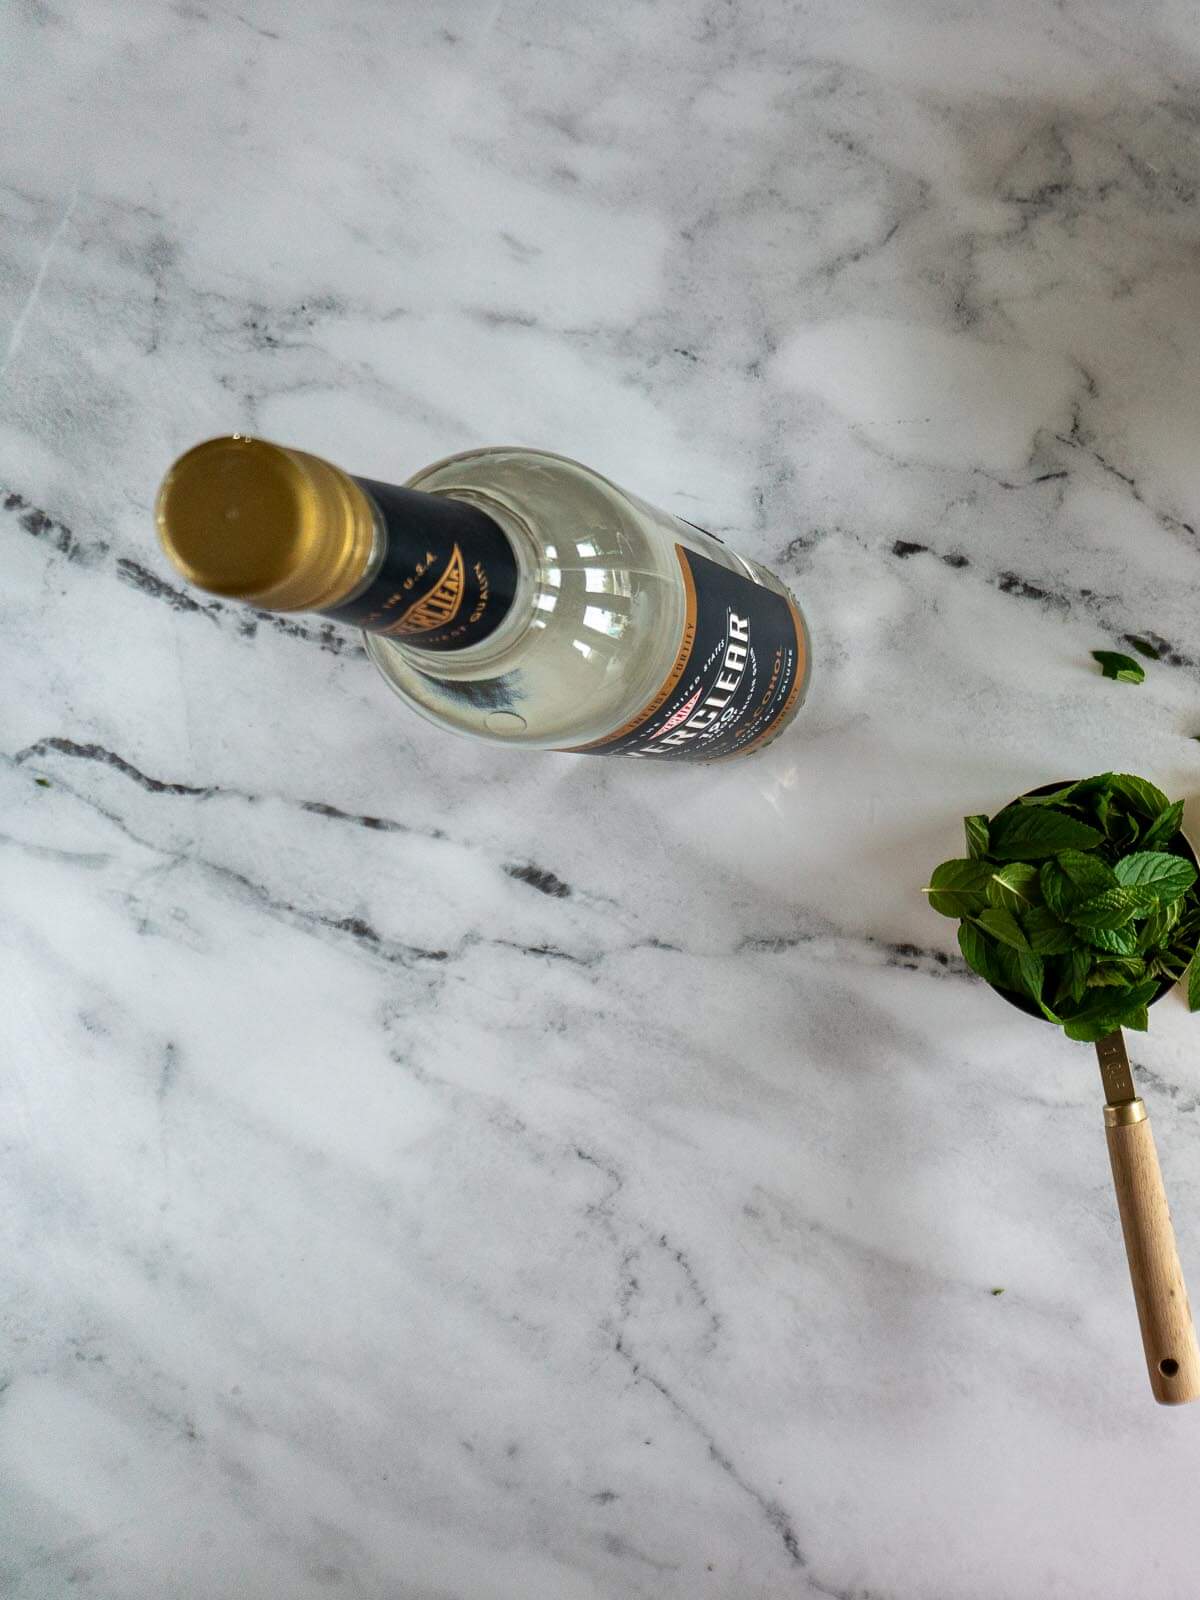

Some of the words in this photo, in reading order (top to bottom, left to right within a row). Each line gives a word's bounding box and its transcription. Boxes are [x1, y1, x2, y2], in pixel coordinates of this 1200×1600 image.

[673, 623, 694, 678] FORTIFY
[777, 649, 793, 702] VOLUME
[664, 676, 701, 717] UNITED
[703, 639, 725, 672] STATES
[698, 707, 735, 739] 190
